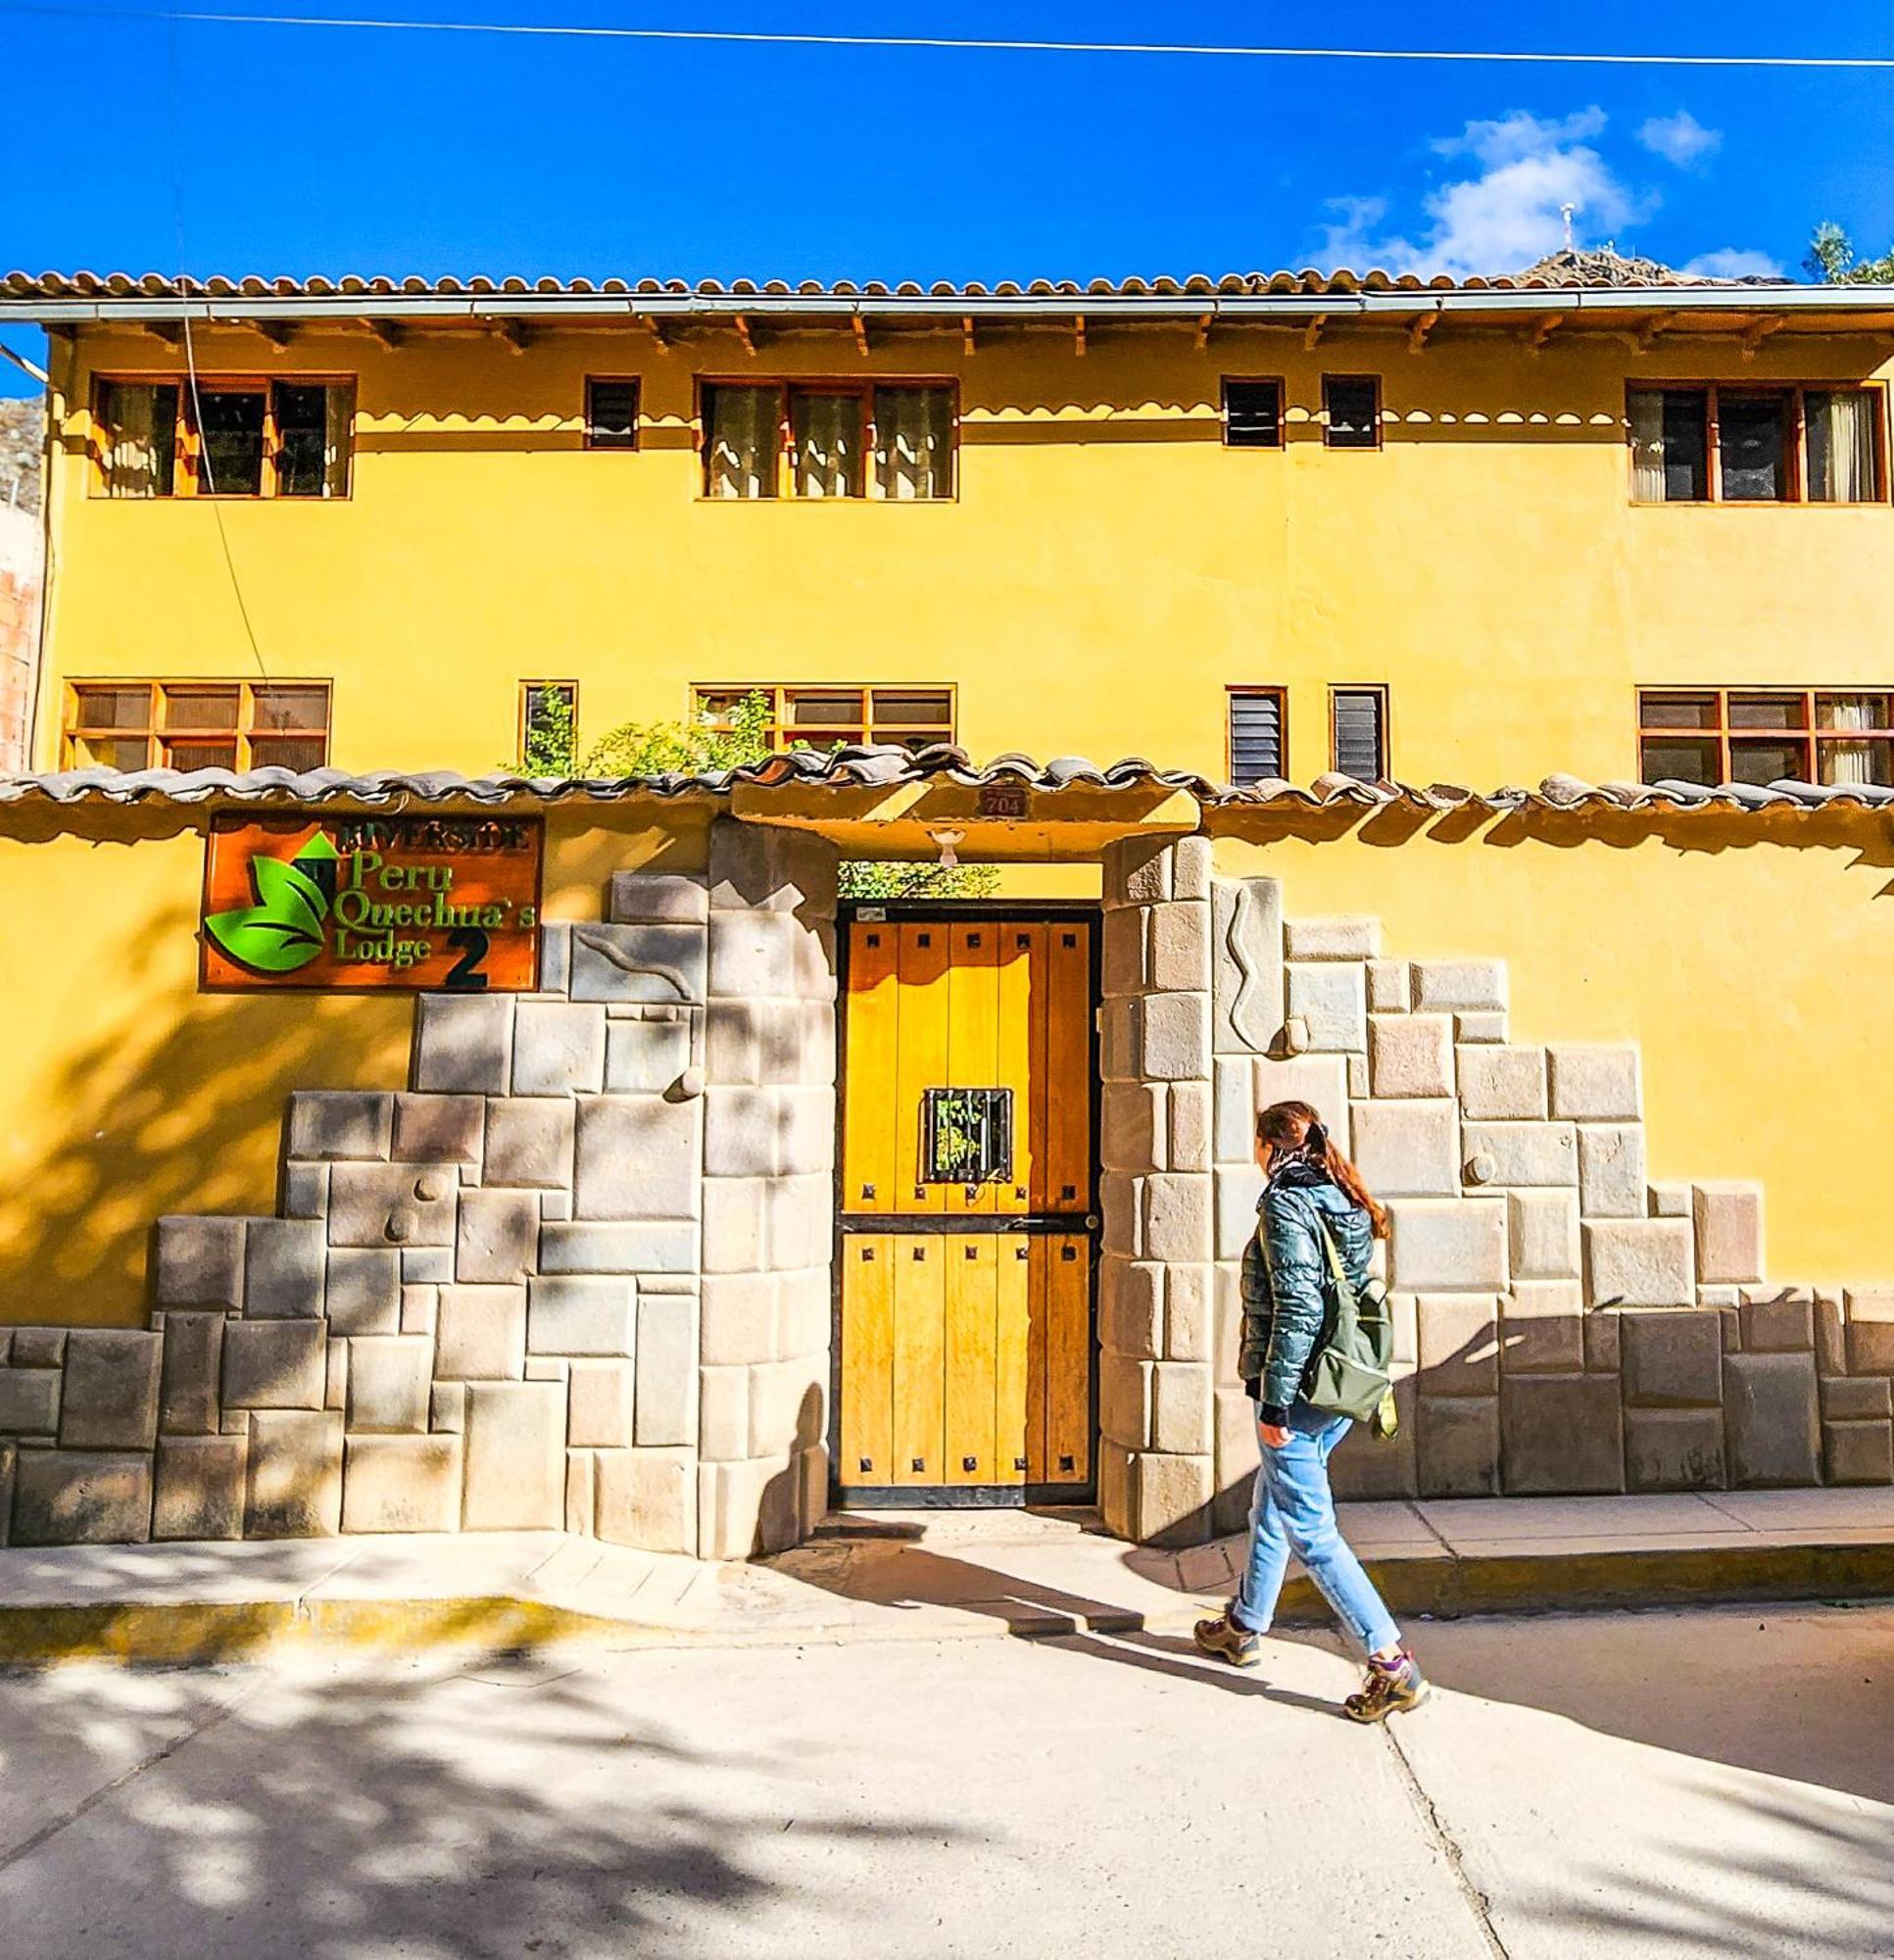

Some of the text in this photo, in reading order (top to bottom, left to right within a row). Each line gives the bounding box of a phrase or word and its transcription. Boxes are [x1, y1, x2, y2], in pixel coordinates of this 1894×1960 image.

[987, 797, 1019, 814] 704
[340, 821, 532, 851] RIVERSIDE
[350, 851, 454, 892] Peru
[336, 928, 491, 989] Lodge 2
